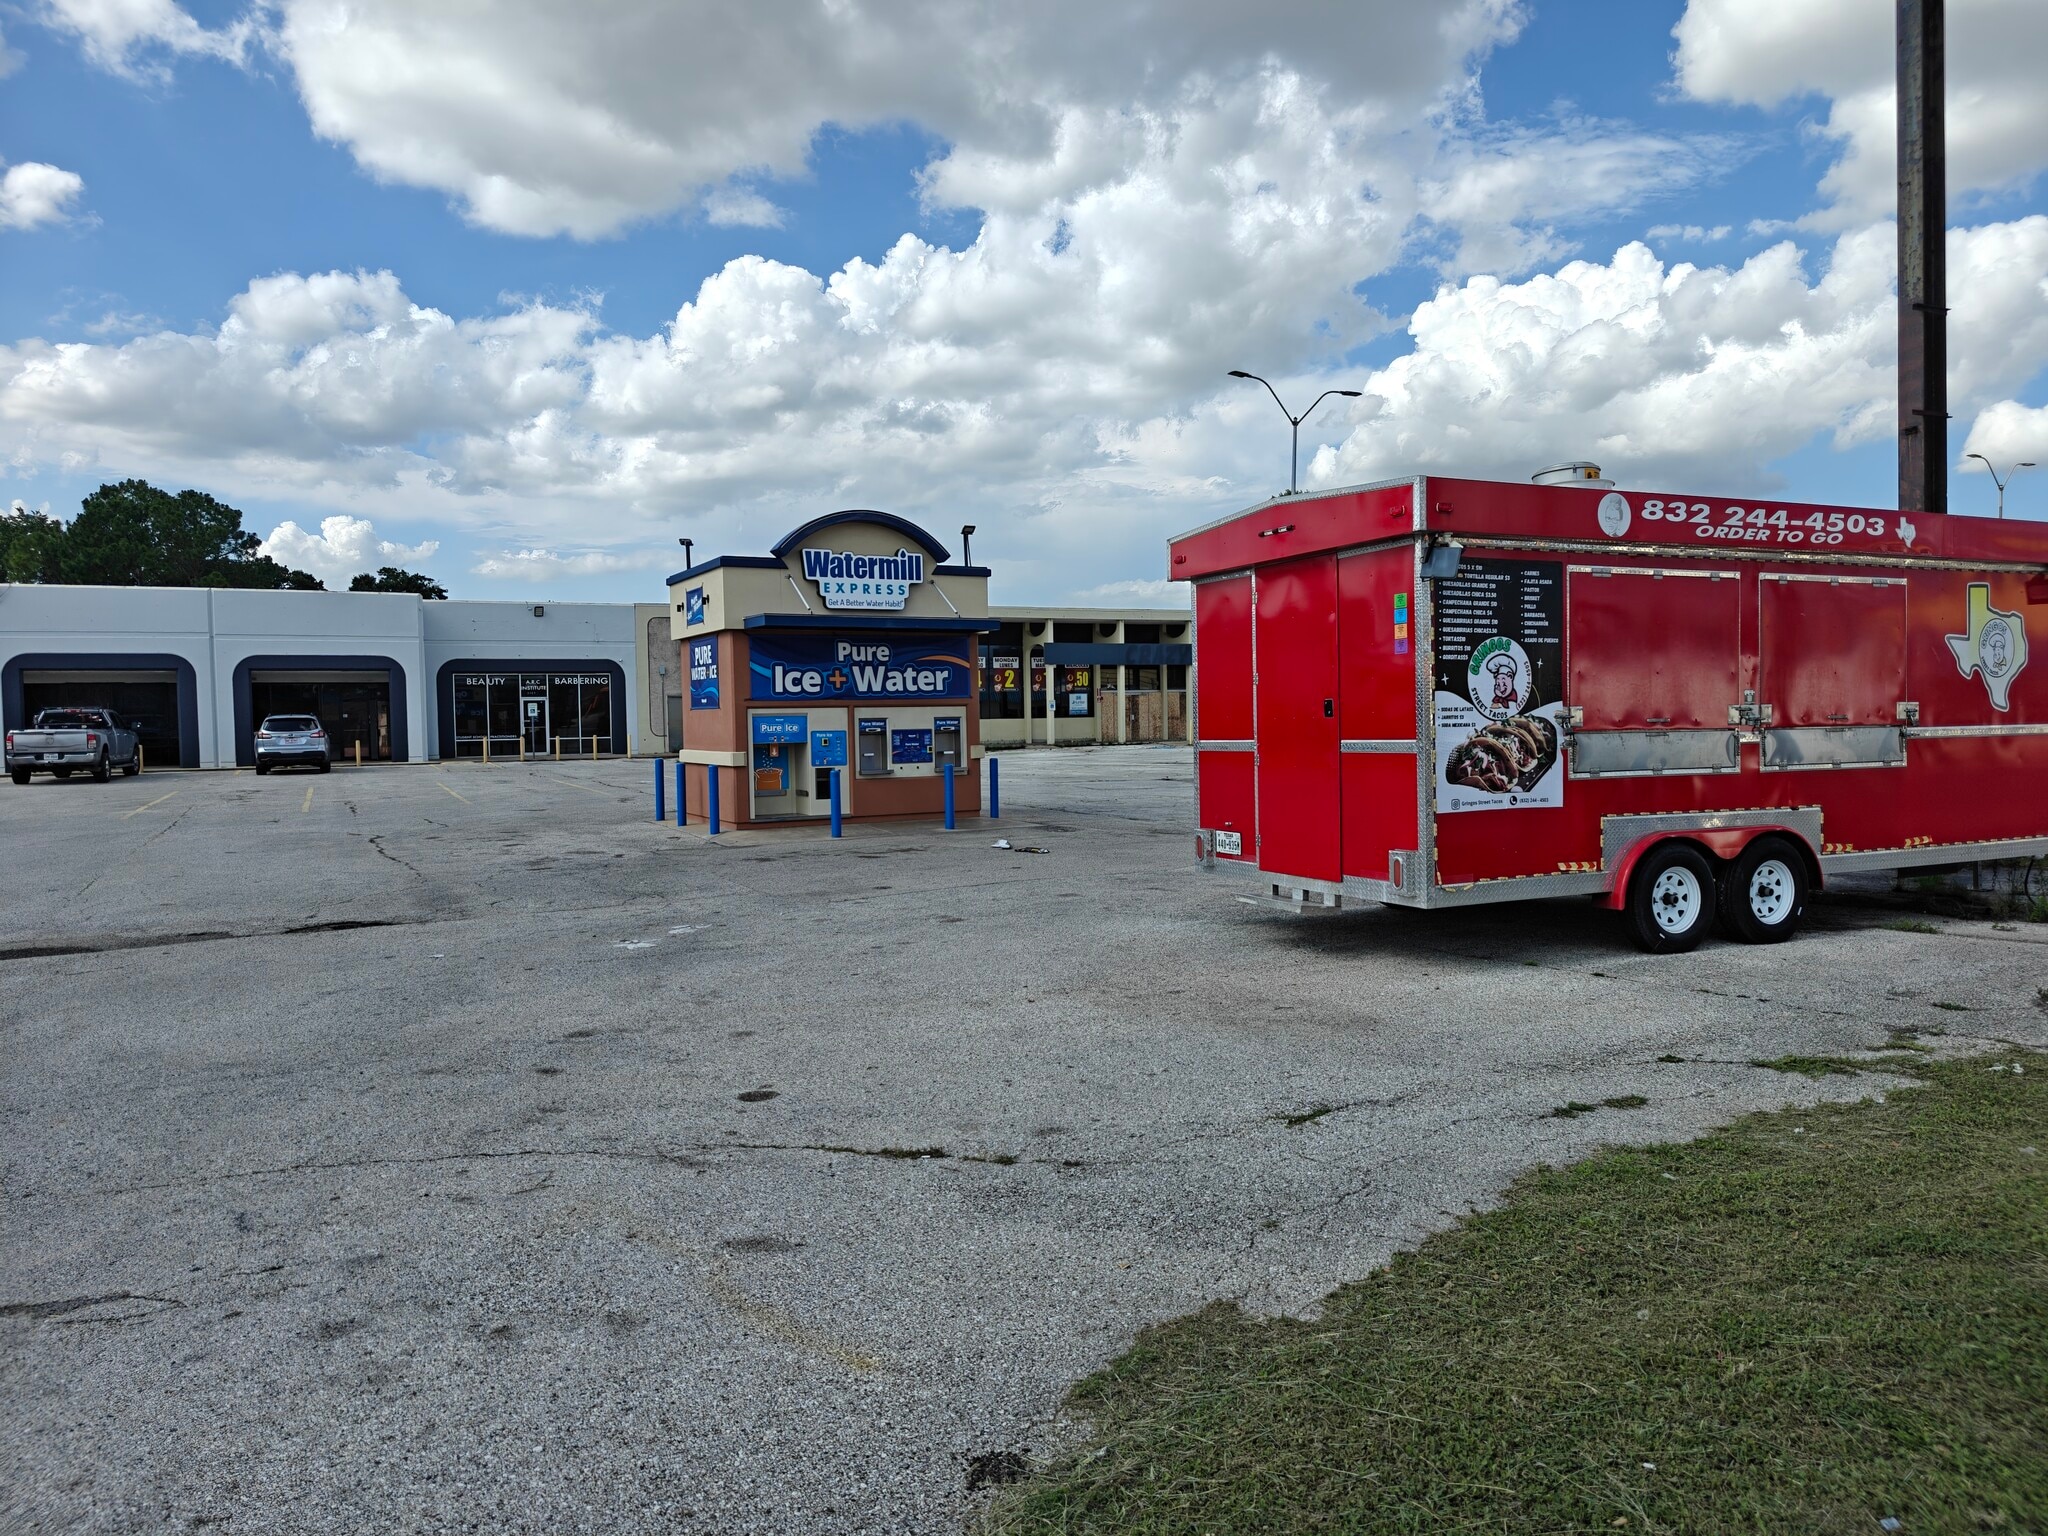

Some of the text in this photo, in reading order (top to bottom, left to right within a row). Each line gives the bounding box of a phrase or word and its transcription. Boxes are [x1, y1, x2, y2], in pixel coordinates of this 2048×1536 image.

[1641, 500, 1885, 536] 832 244-4503
[1695, 525, 1844, 545] ORDER TO GO
[804, 550, 922, 580] Watermill
[824, 582, 906, 596] EXPRESS
[1442, 581, 1472, 589] QUESADILLAS
[1442, 590, 1472, 598] QUESADILLAS
[828, 599, 839, 607] Get
[866, 600, 883, 608] Water
[1981, 621, 2008, 650] GRINGOS
[694, 645, 712, 666] PURE
[837, 642, 890, 662] Pure
[1469, 637, 1512, 675] GRINGOS
[466, 677, 506, 686] BEAUTY
[554, 677, 609, 685] BARBERING
[691, 668, 707, 680] WATER
[709, 665, 718, 679] ICE
[774, 665, 822, 693] Ice
[851, 666, 949, 692] Water
[1004, 669, 1015, 688] 2
[1074, 671, 1089, 687] .50
[1470, 687, 1509, 720] STREET TACOS
[761, 724, 799, 732] Pure Ice
